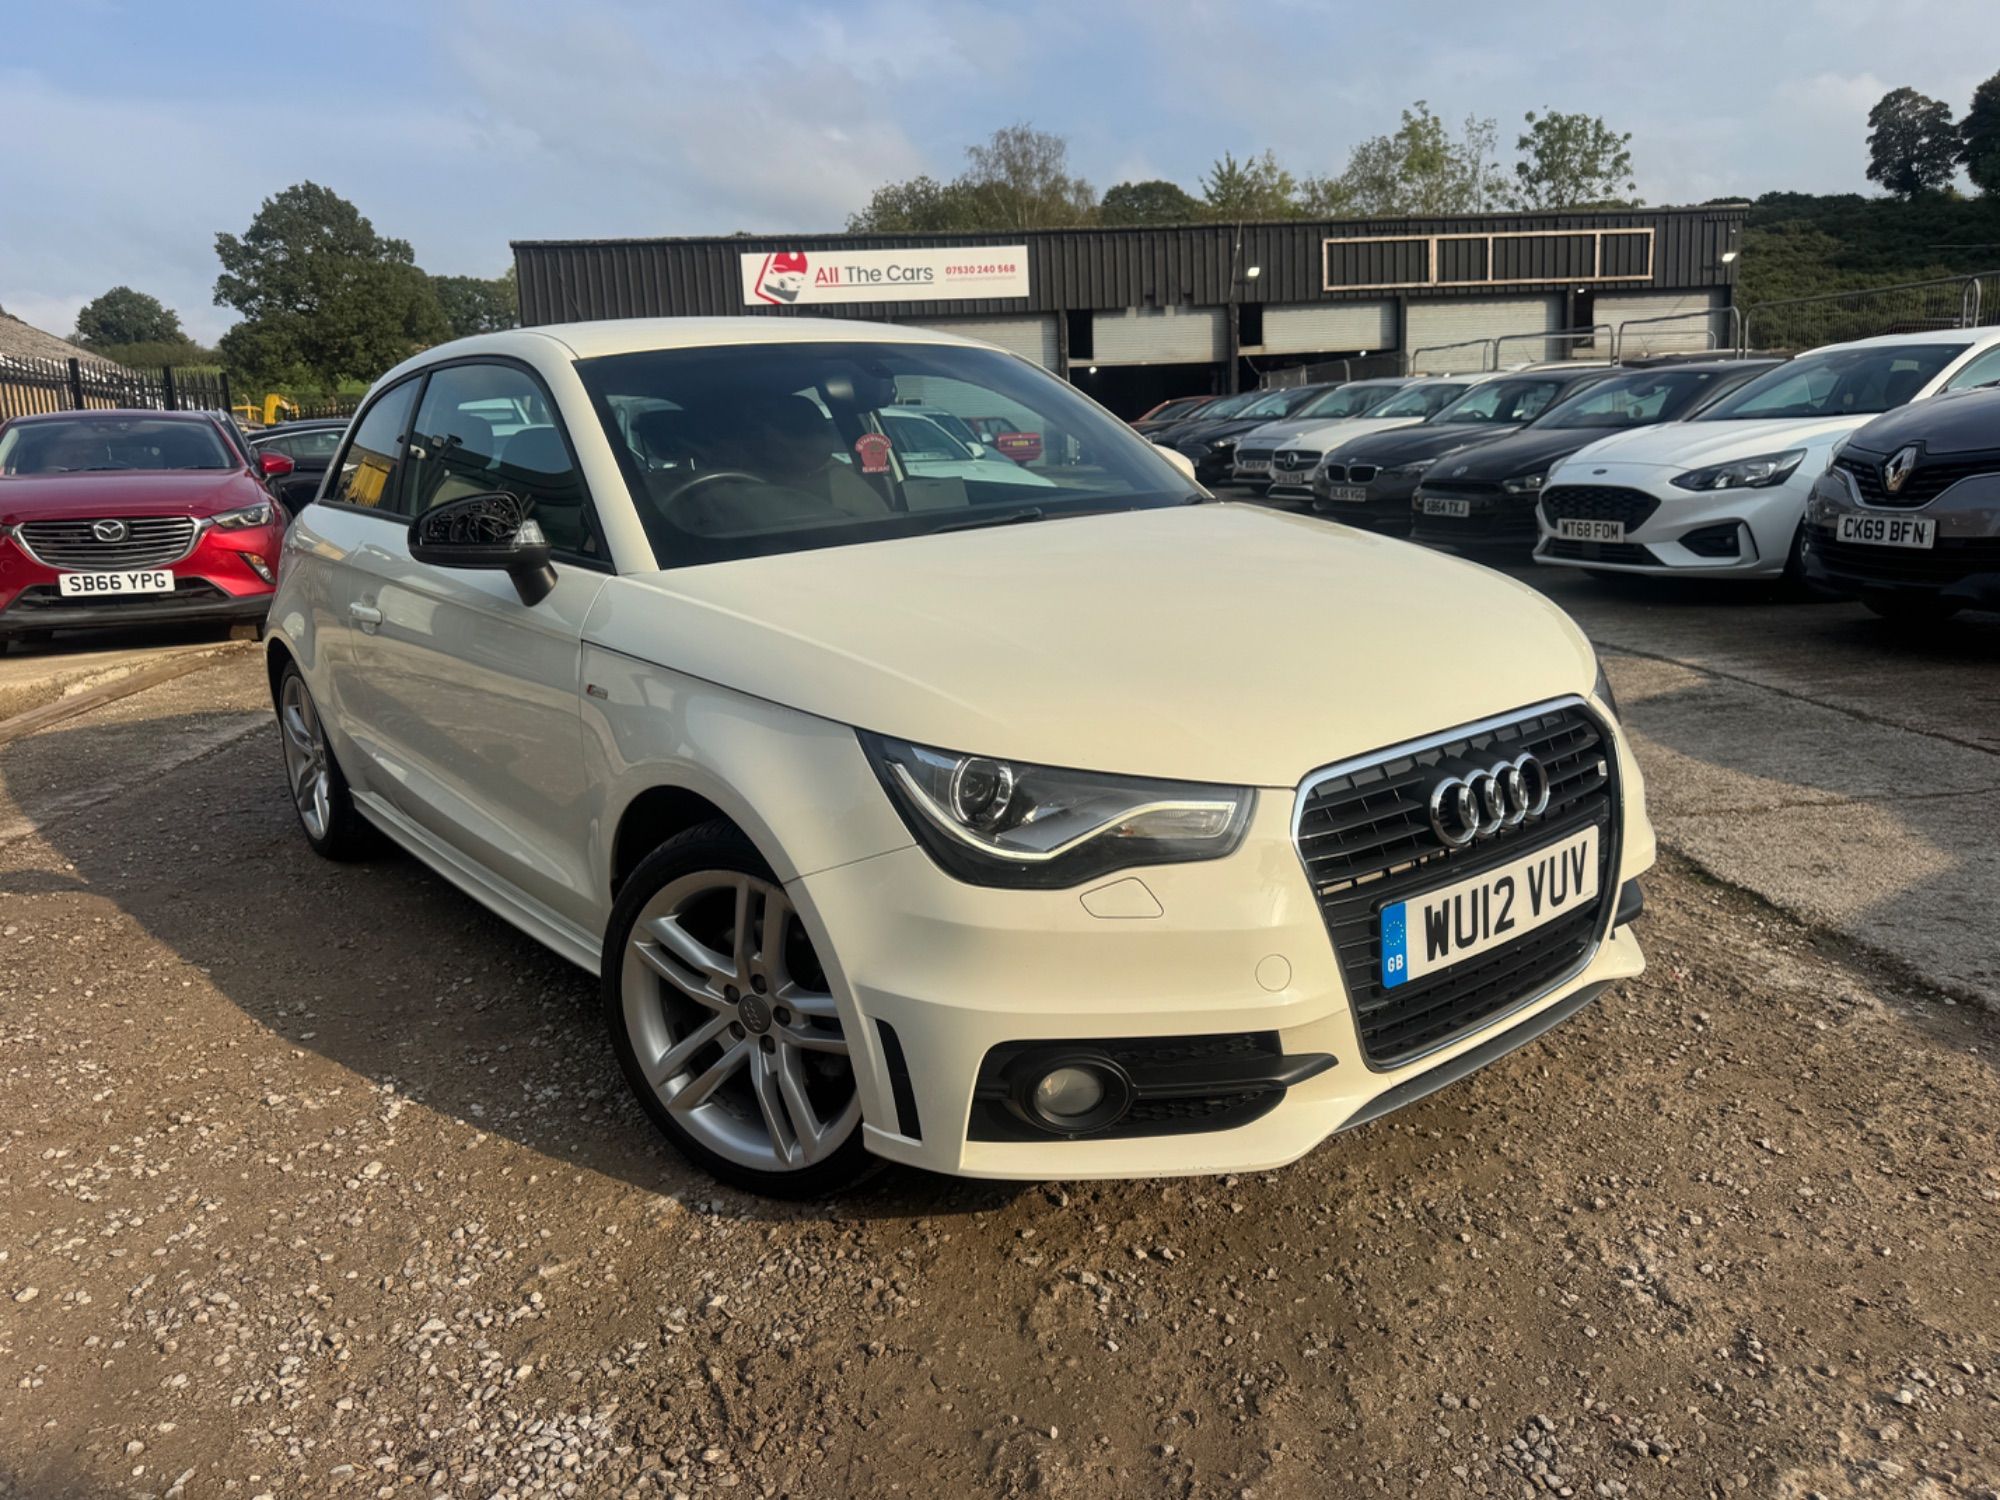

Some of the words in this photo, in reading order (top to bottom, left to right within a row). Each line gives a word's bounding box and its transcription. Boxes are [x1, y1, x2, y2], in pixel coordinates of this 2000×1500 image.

[815, 267, 839, 283] All
[845, 266, 882, 283] The
[887, 264, 934, 281] Cars
[945, 265, 975, 275] 07530
[977, 265, 996, 274] 240
[997, 264, 1016, 273] 568
[1426, 500, 1447, 513] SB64
[1449, 501, 1466, 514] TXJ
[1562, 521, 1592, 537] WT68
[1594, 523, 1619, 539] FOM
[1843, 518, 1885, 541] CK69
[1889, 520, 1926, 544] BFN
[69, 574, 122, 592] SB66
[127, 572, 167, 590] YPG
[1424, 874, 1515, 962] WU12
[1527, 841, 1587, 917] VUV
[1387, 954, 1404, 973] GB
